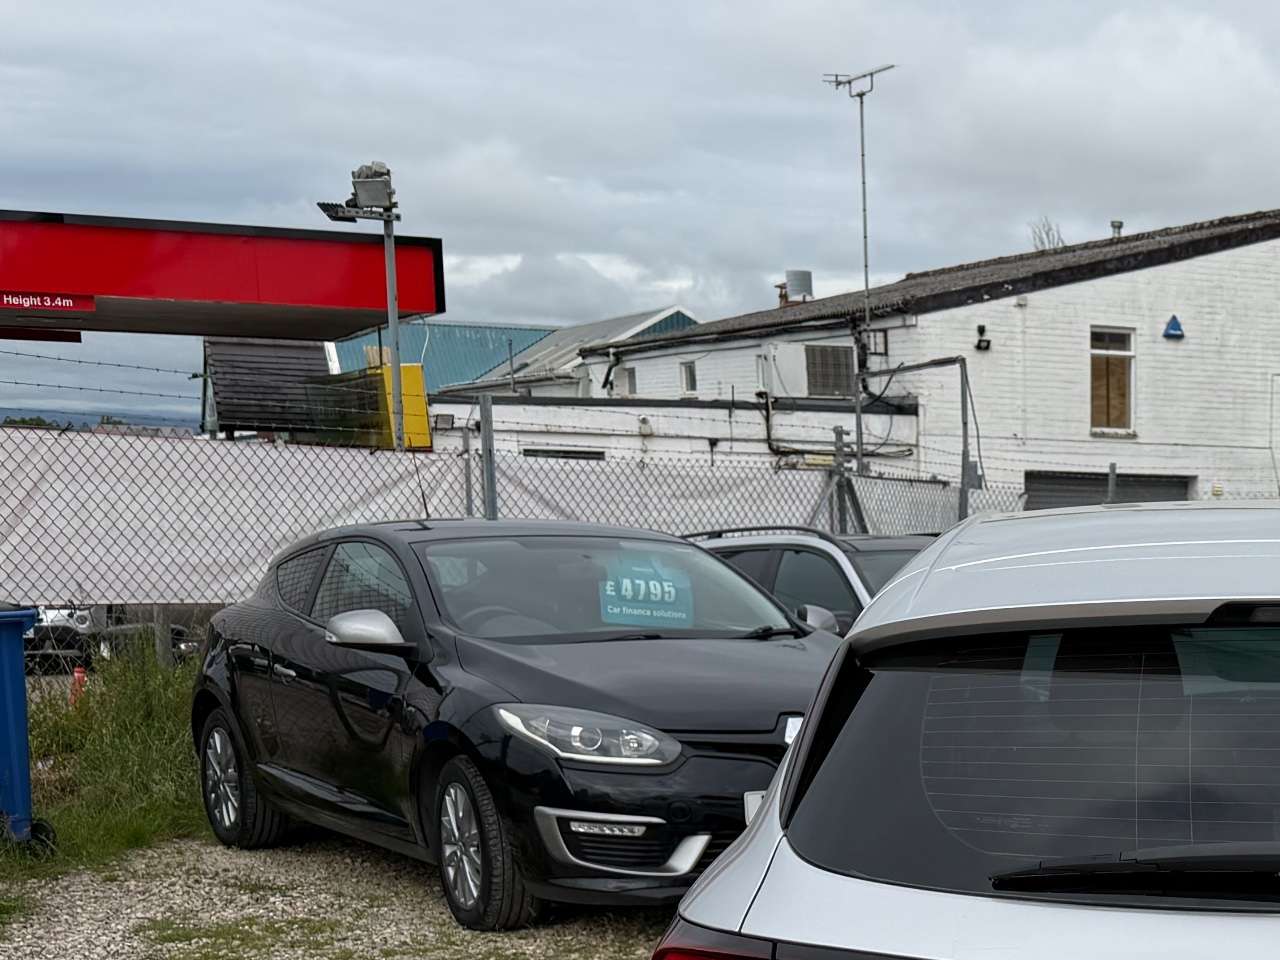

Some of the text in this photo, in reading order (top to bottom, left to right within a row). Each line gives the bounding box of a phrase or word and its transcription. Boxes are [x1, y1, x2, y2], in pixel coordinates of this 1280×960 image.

[3, 294, 73, 308] Height 3.4m
[620, 577, 677, 603] 4795
[607, 604, 621, 615] Car
[622, 606, 652, 617] finance
